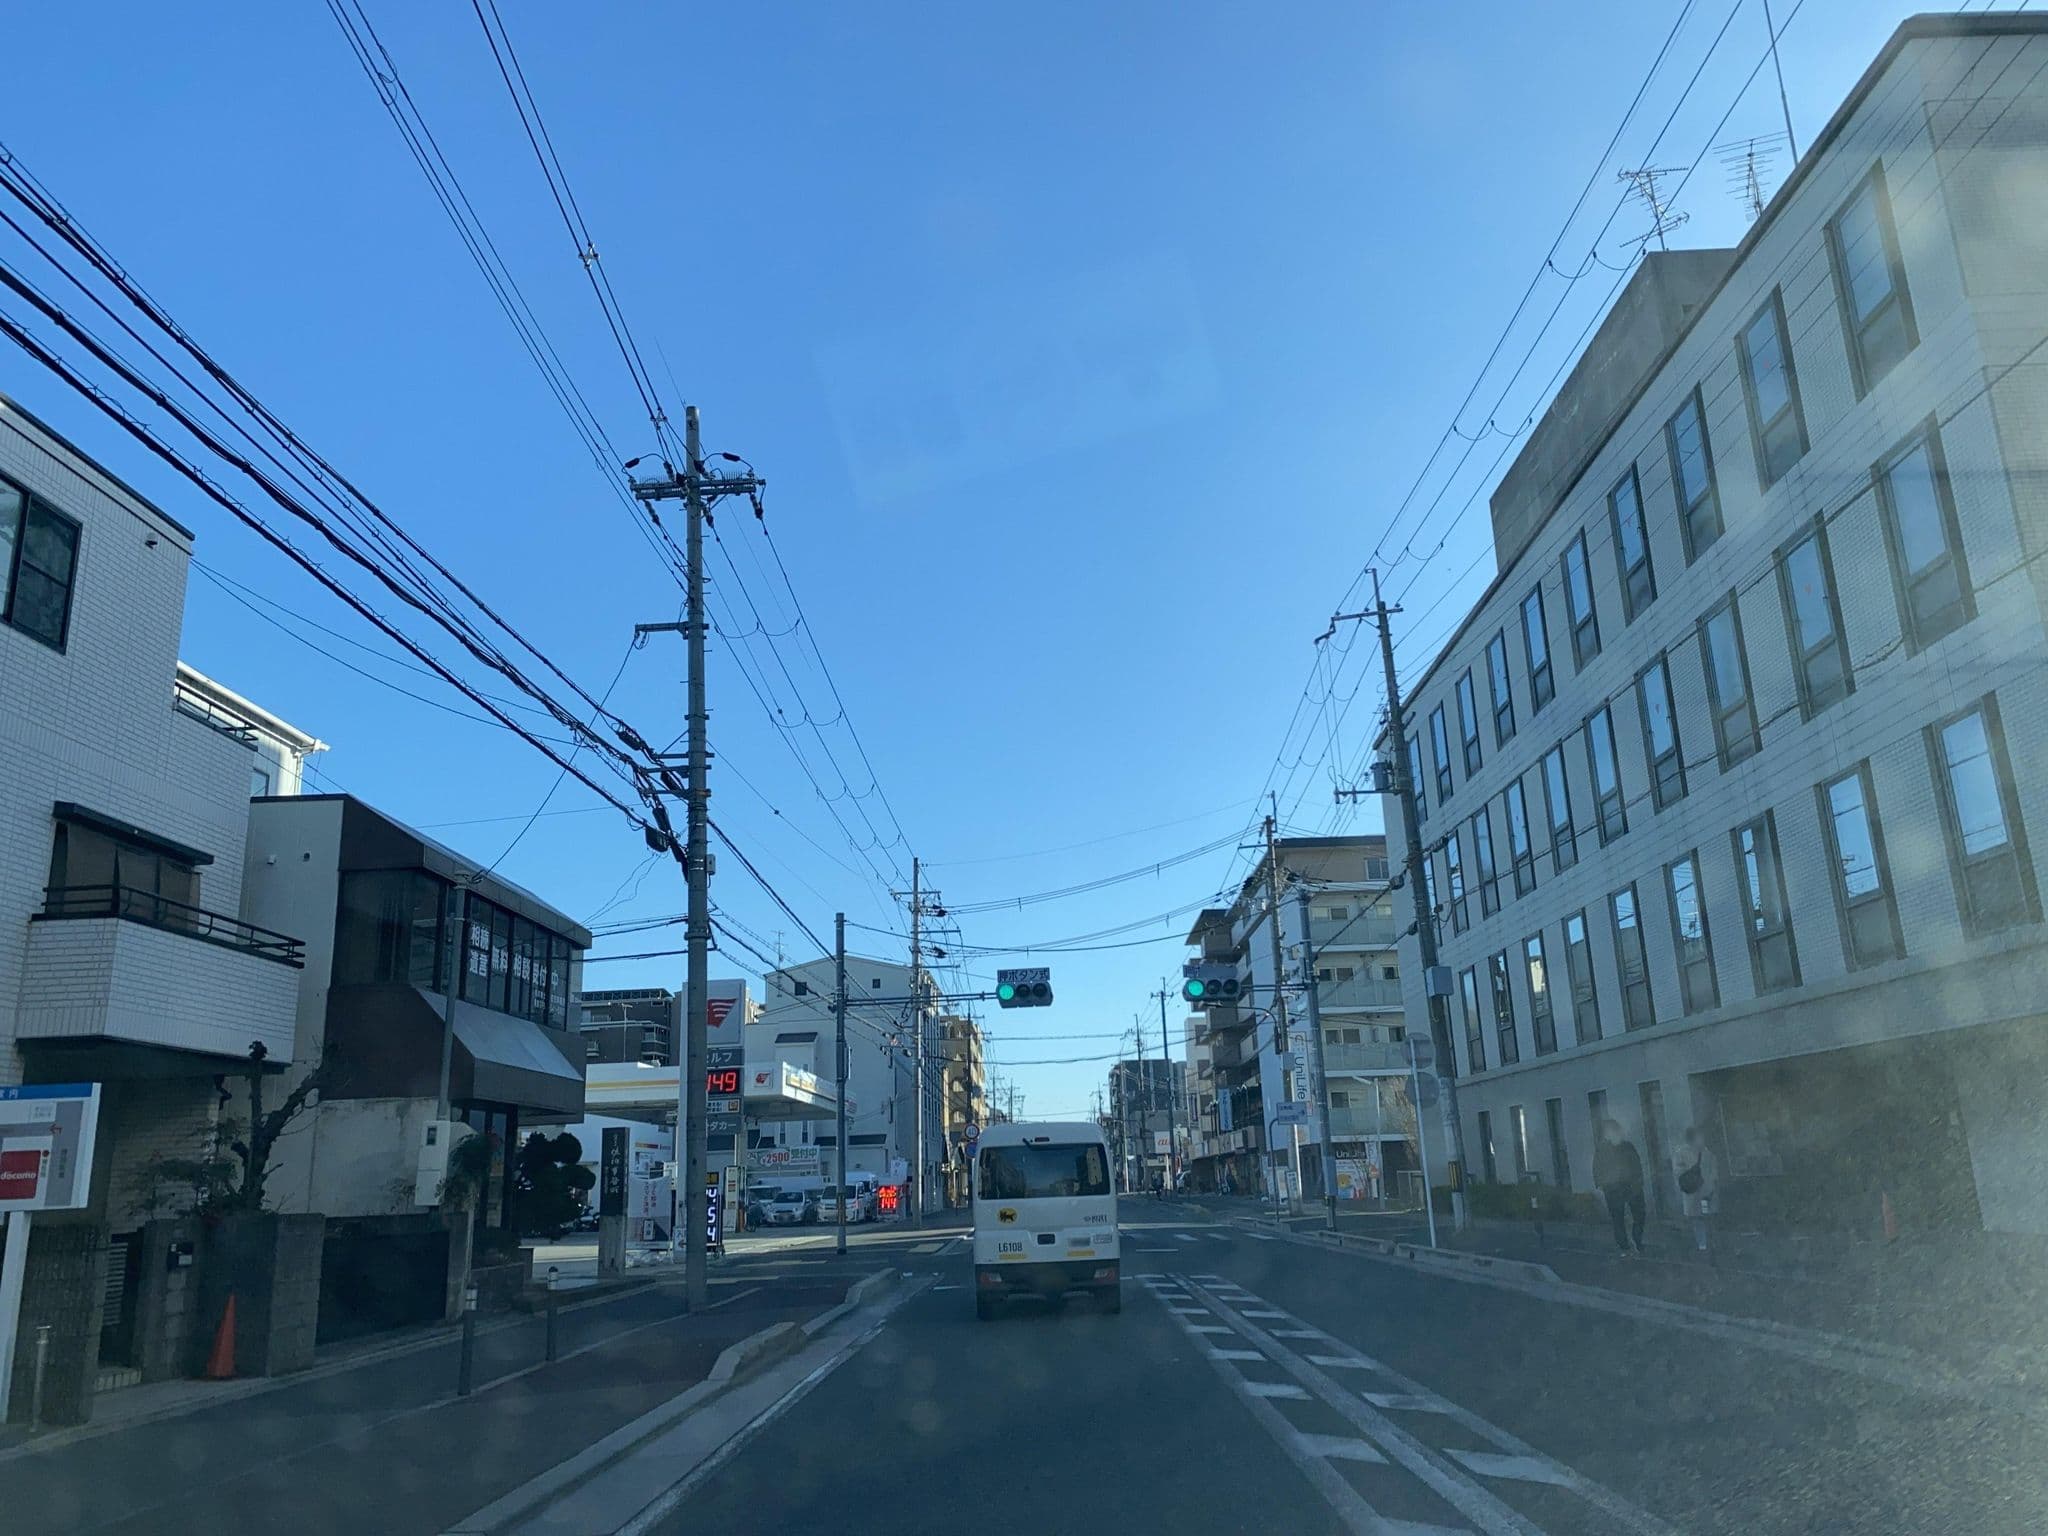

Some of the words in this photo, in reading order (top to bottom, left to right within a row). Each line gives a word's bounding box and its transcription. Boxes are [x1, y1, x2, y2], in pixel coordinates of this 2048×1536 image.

[472, 924, 489, 950] 相続
[470, 950, 487, 976] 遺言
[706, 1072, 737, 1092] 149
[1294, 1056, 1307, 1100] UniLife
[0, 1171, 37, 1180] docomo
